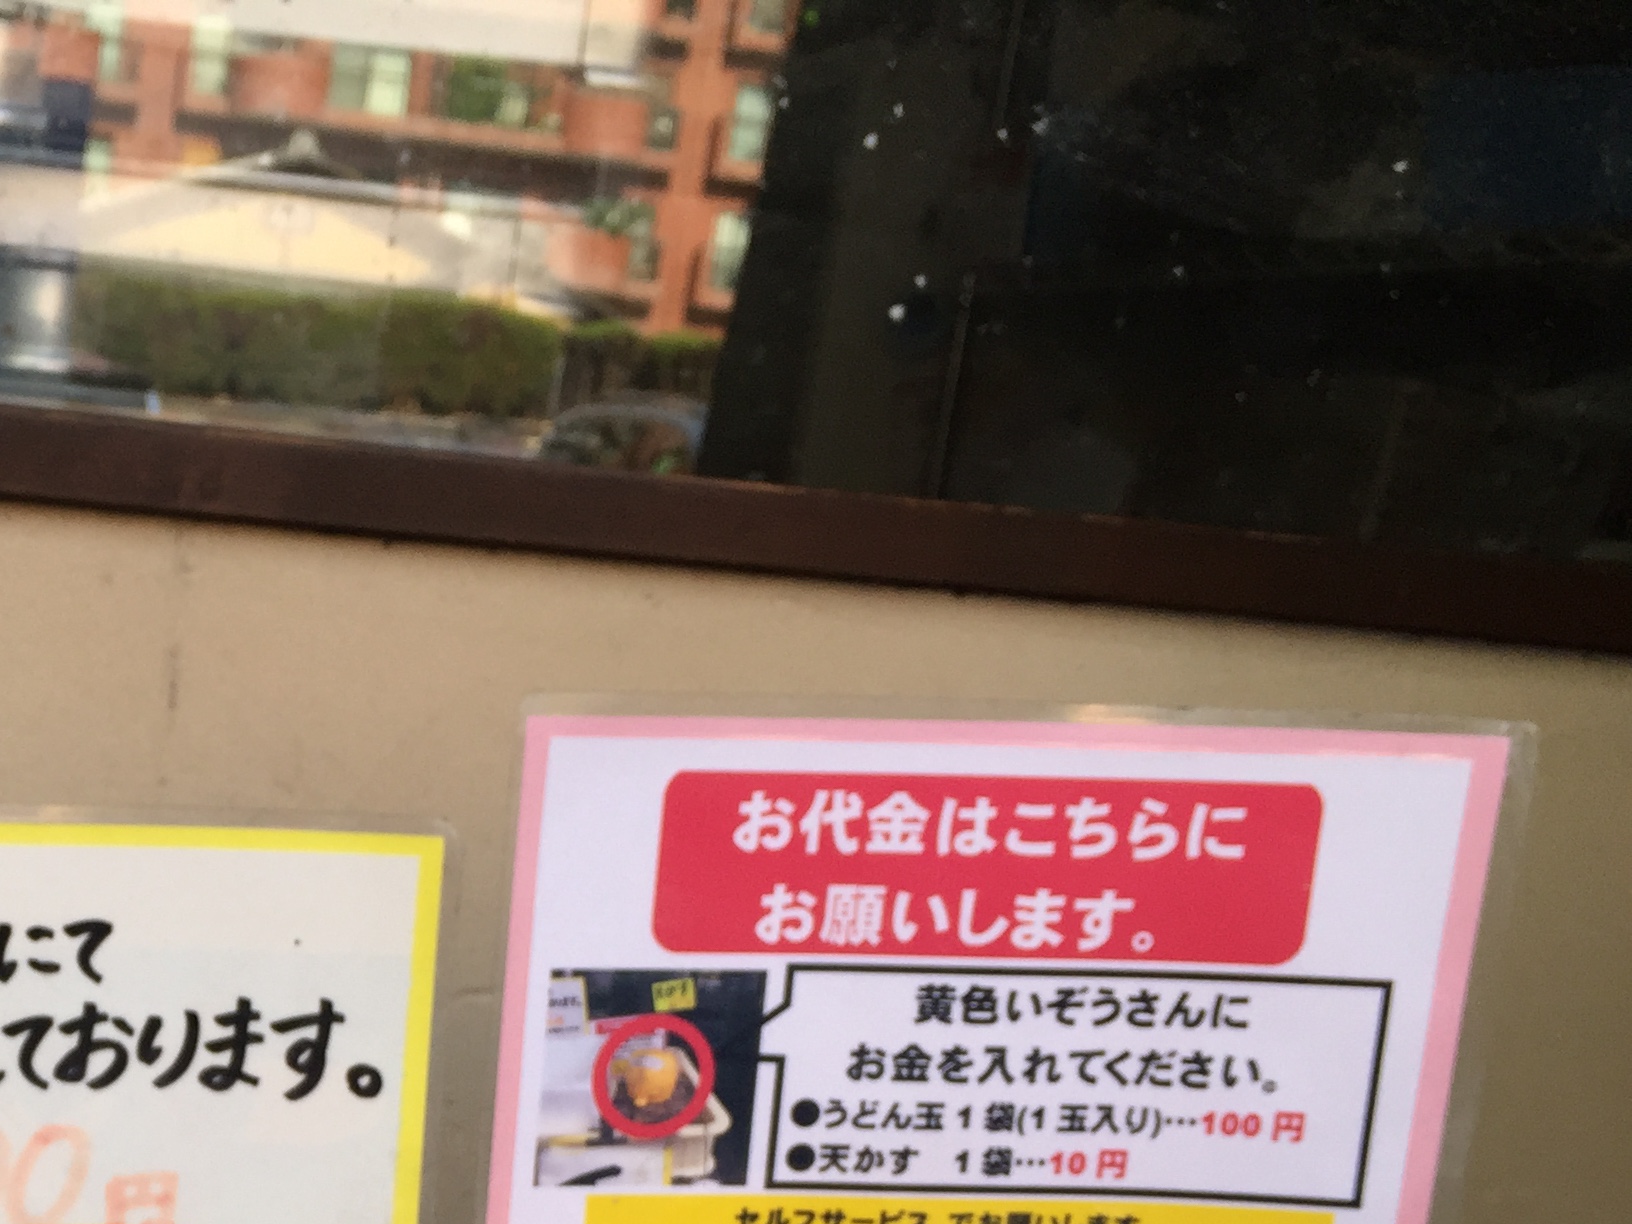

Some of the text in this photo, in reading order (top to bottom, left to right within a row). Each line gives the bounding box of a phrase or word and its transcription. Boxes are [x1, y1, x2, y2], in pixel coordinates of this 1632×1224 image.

[731, 788, 1250, 865] お代金はこちらに
[753, 884, 1158, 955] お願いします。
[913, 983, 1252, 1031] 黄色いぞうさんに
[844, 1042, 1278, 1094] お金を入れてください。
